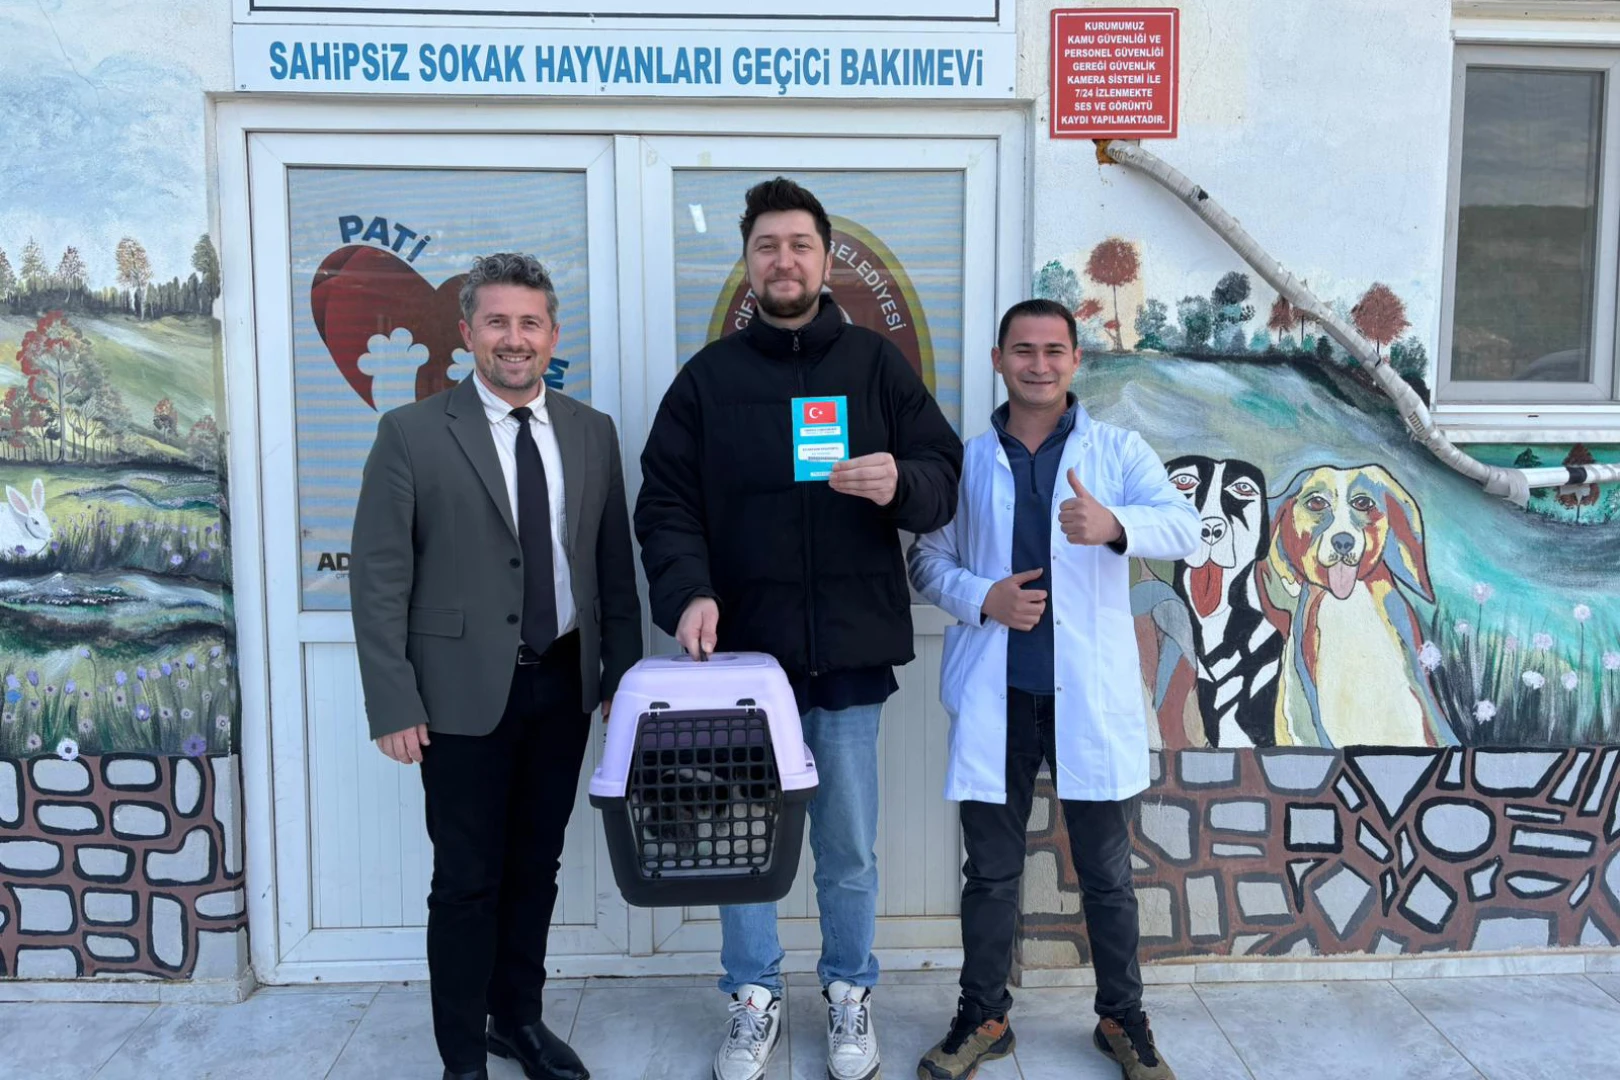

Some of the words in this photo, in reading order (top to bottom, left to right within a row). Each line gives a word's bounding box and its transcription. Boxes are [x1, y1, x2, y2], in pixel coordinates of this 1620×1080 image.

[1085, 22, 1144, 30] KURUMUMUZ
[1068, 36, 1094, 44] KAMU
[1098, 34, 1146, 44] GÜVENLİĞİ
[1149, 35, 1161, 43] VE
[1065, 49, 1111, 57] PERSONEL
[1115, 47, 1164, 57] GÜVENLİĞİ
[419, 43, 526, 82] SOKAK
[535, 45, 721, 84] HAYVANLARI
[1073, 60, 1106, 71] GEREĞİ
[1109, 61, 1156, 71] GÜVENLİK
[1067, 76, 1105, 84] KAMERA
[1108, 74, 1144, 83] SİSTEMİ
[1147, 74, 1161, 84] İLE
[1075, 89, 1093, 97] 7/24
[1096, 87, 1153, 97] İZLENMEKTE
[1075, 102, 1091, 111] SES
[1094, 102, 1106, 111] VE
[1109, 100, 1153, 111] GÖRÜNTÜ
[1062, 116, 1088, 124] KAYDI
[1092, 115, 1165, 124] YAPILMAKTADIR.
